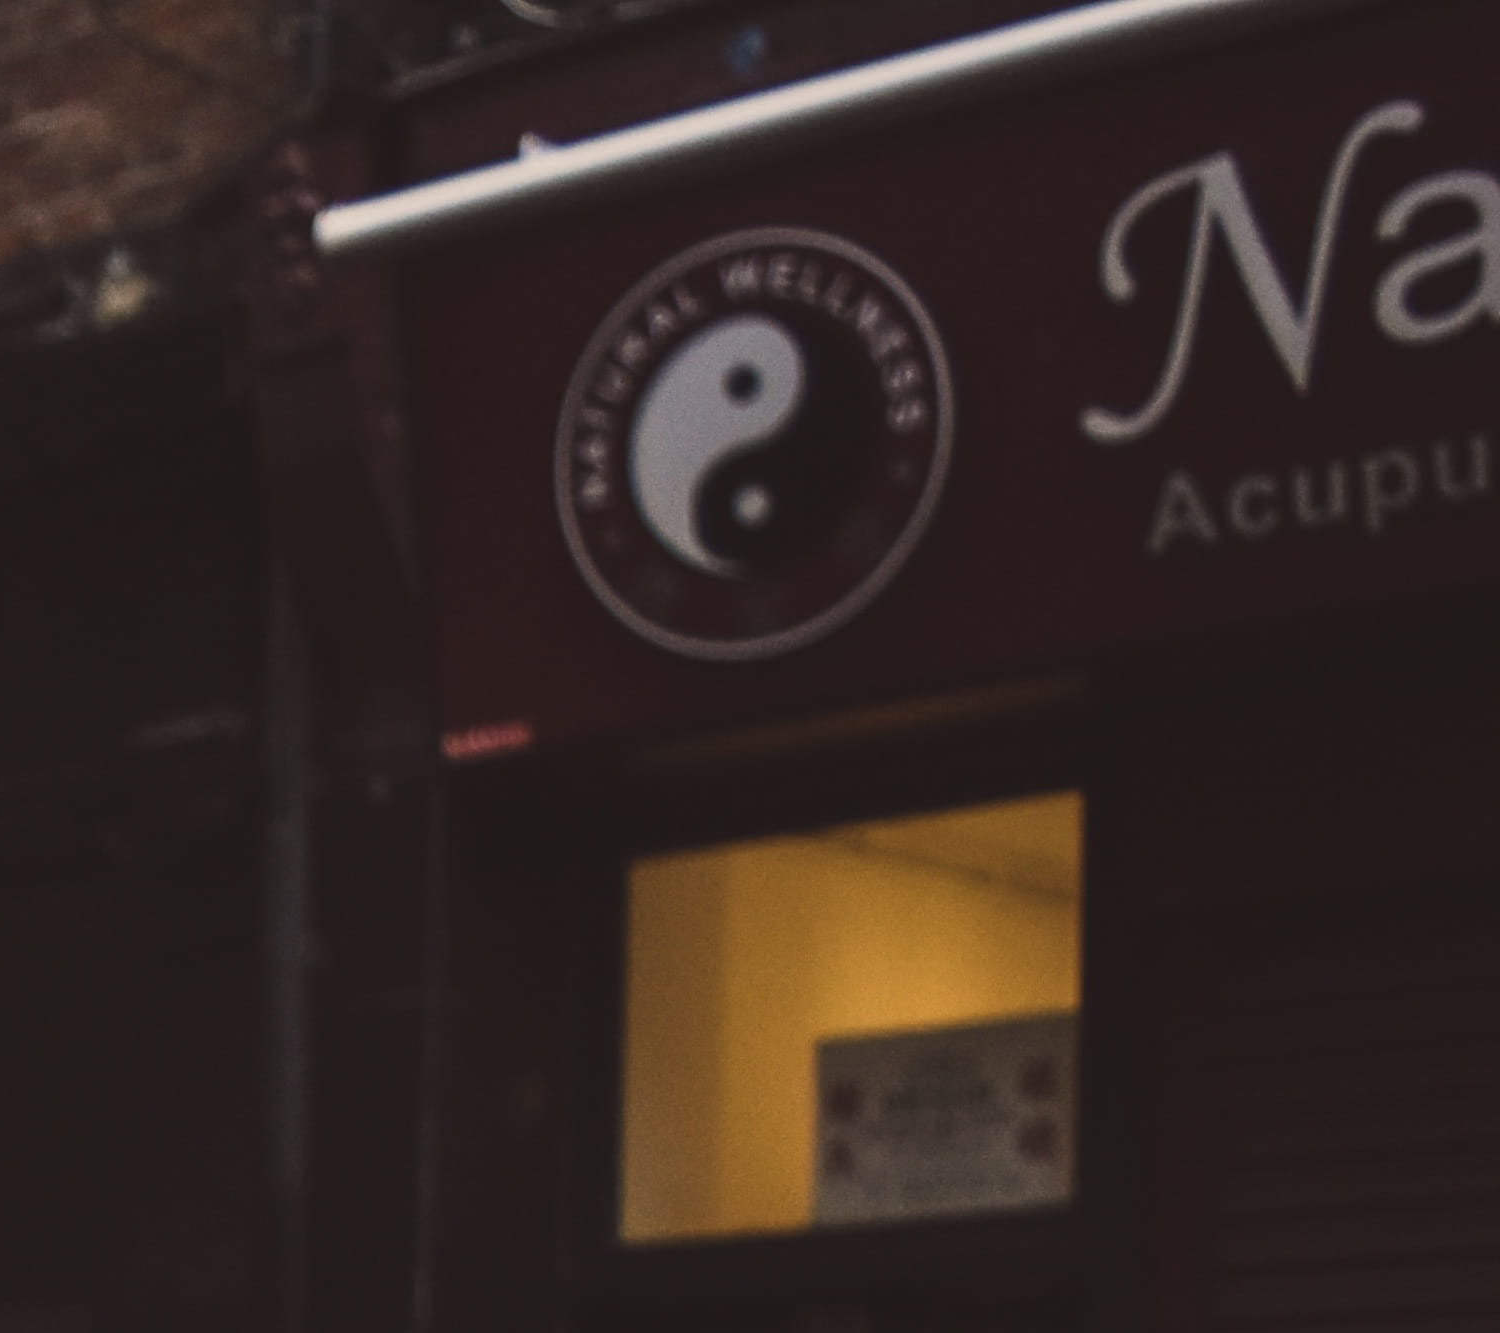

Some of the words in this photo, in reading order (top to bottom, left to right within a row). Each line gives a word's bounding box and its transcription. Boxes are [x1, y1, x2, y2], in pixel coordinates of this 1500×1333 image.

[576, 280, 704, 511] NATURAL
[717, 250, 928, 434] WELLNESS
[1077, 98, 1500, 447] Na
[1143, 431, 1494, 560] Acupu
